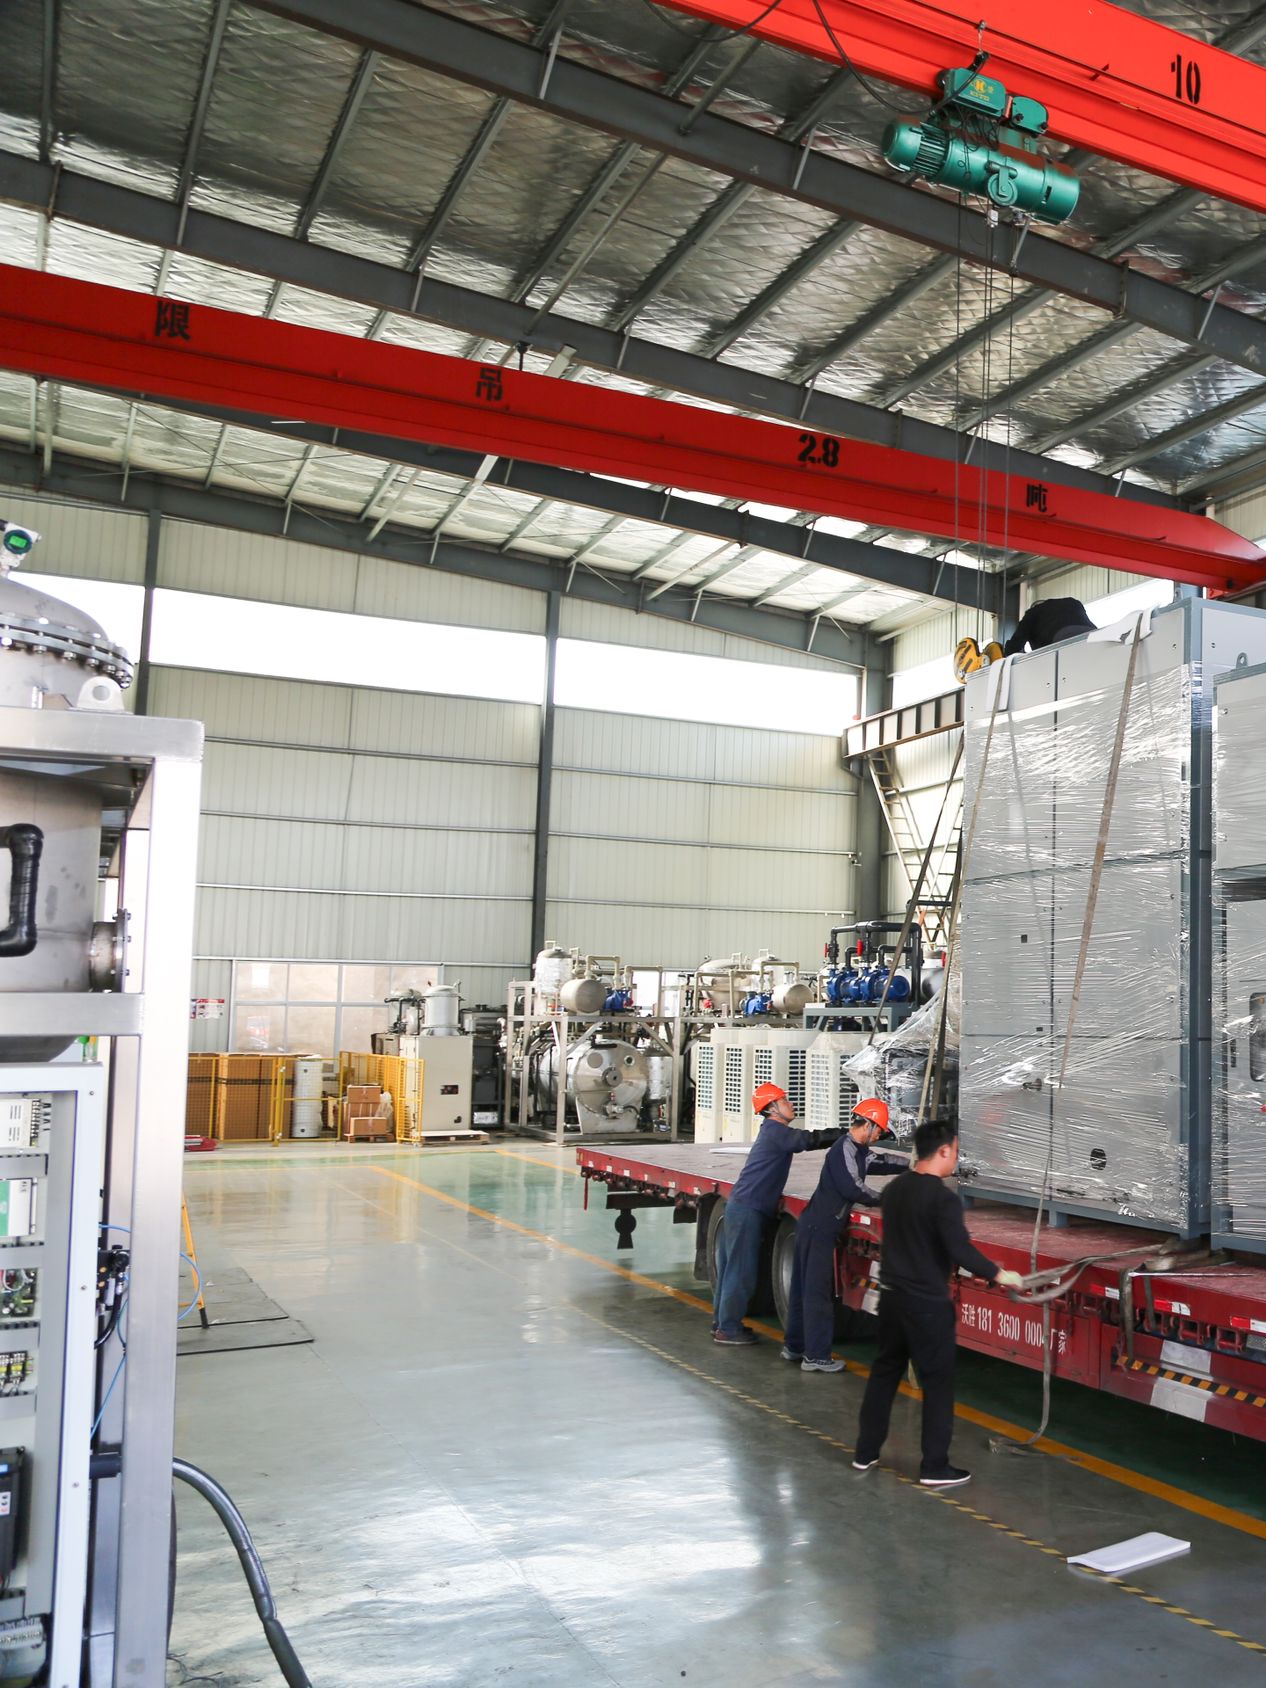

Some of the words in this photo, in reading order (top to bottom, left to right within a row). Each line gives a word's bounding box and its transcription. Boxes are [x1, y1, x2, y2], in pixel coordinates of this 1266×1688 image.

[1171, 54, 1201, 105] 10
[155, 301, 191, 341] 限
[476, 367, 503, 401] 吊
[1026, 483, 1048, 513] 吨
[977, 1307, 992, 1333] 181
[998, 1312, 1020, 1341] 3600
[1025, 1320, 1045, 1347] 000
